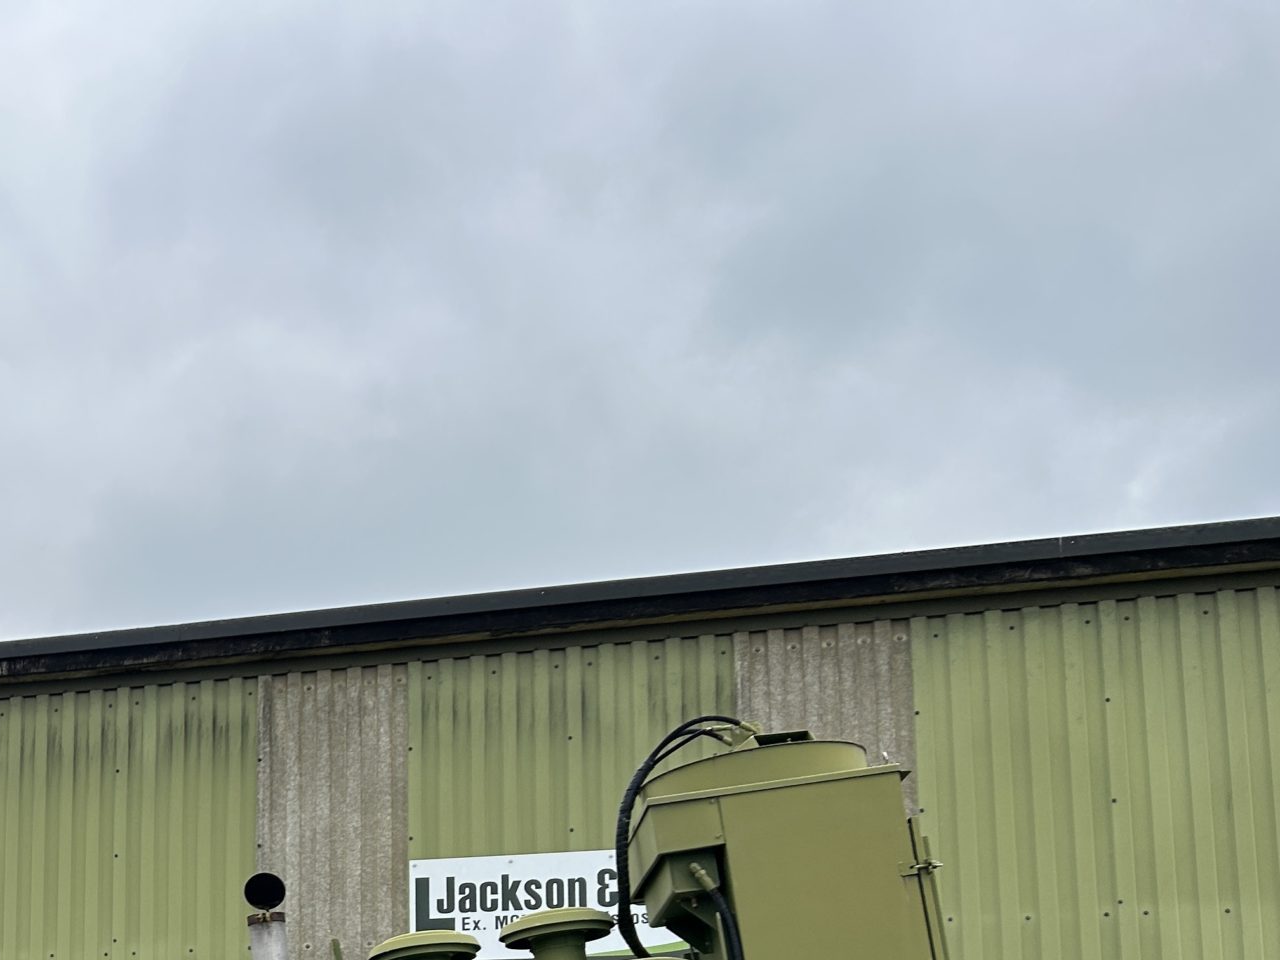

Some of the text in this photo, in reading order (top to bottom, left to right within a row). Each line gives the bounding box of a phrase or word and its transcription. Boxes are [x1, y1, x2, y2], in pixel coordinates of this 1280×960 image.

[436, 873, 587, 915] Jackson
[597, 868, 620, 907] &
[462, 916, 487, 931] Ex.
